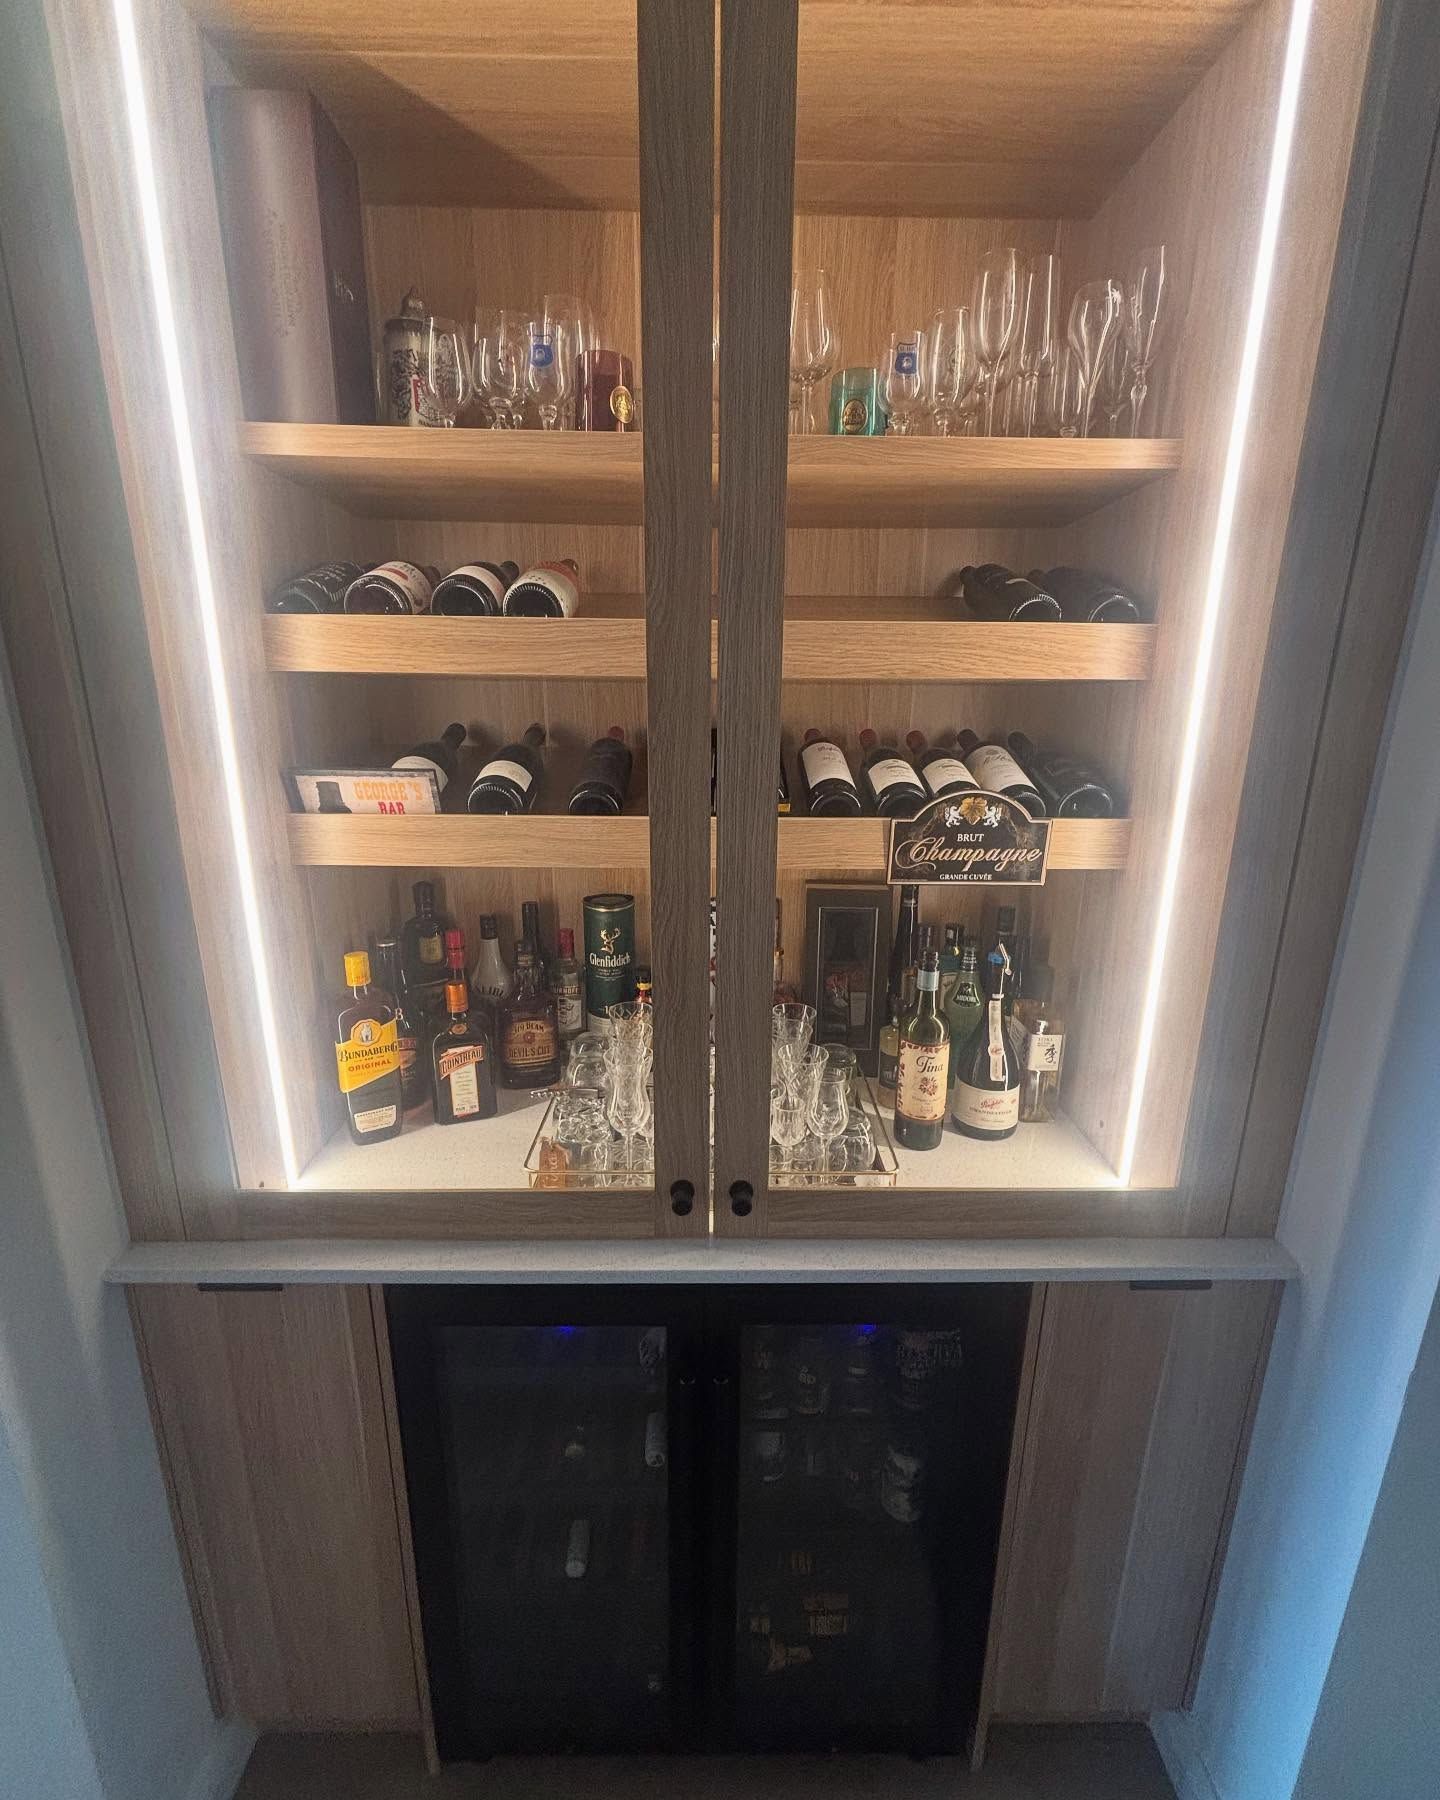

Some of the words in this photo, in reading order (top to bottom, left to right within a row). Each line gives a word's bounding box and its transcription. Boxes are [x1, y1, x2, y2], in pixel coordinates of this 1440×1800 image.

[353, 780, 424, 801] GEORGE'S
[957, 833, 985, 843] BRUT
[895, 836, 1043, 872] Champagne
[939, 873, 969, 881] GRANDE
[968, 872, 993, 881] CUVÉE
[339, 1042, 399, 1063] BUNDABERG
[442, 1048, 483, 1075] COINTREAU
[348, 1059, 392, 1073] ORIGINAL
[916, 1055, 944, 1074] Tina
